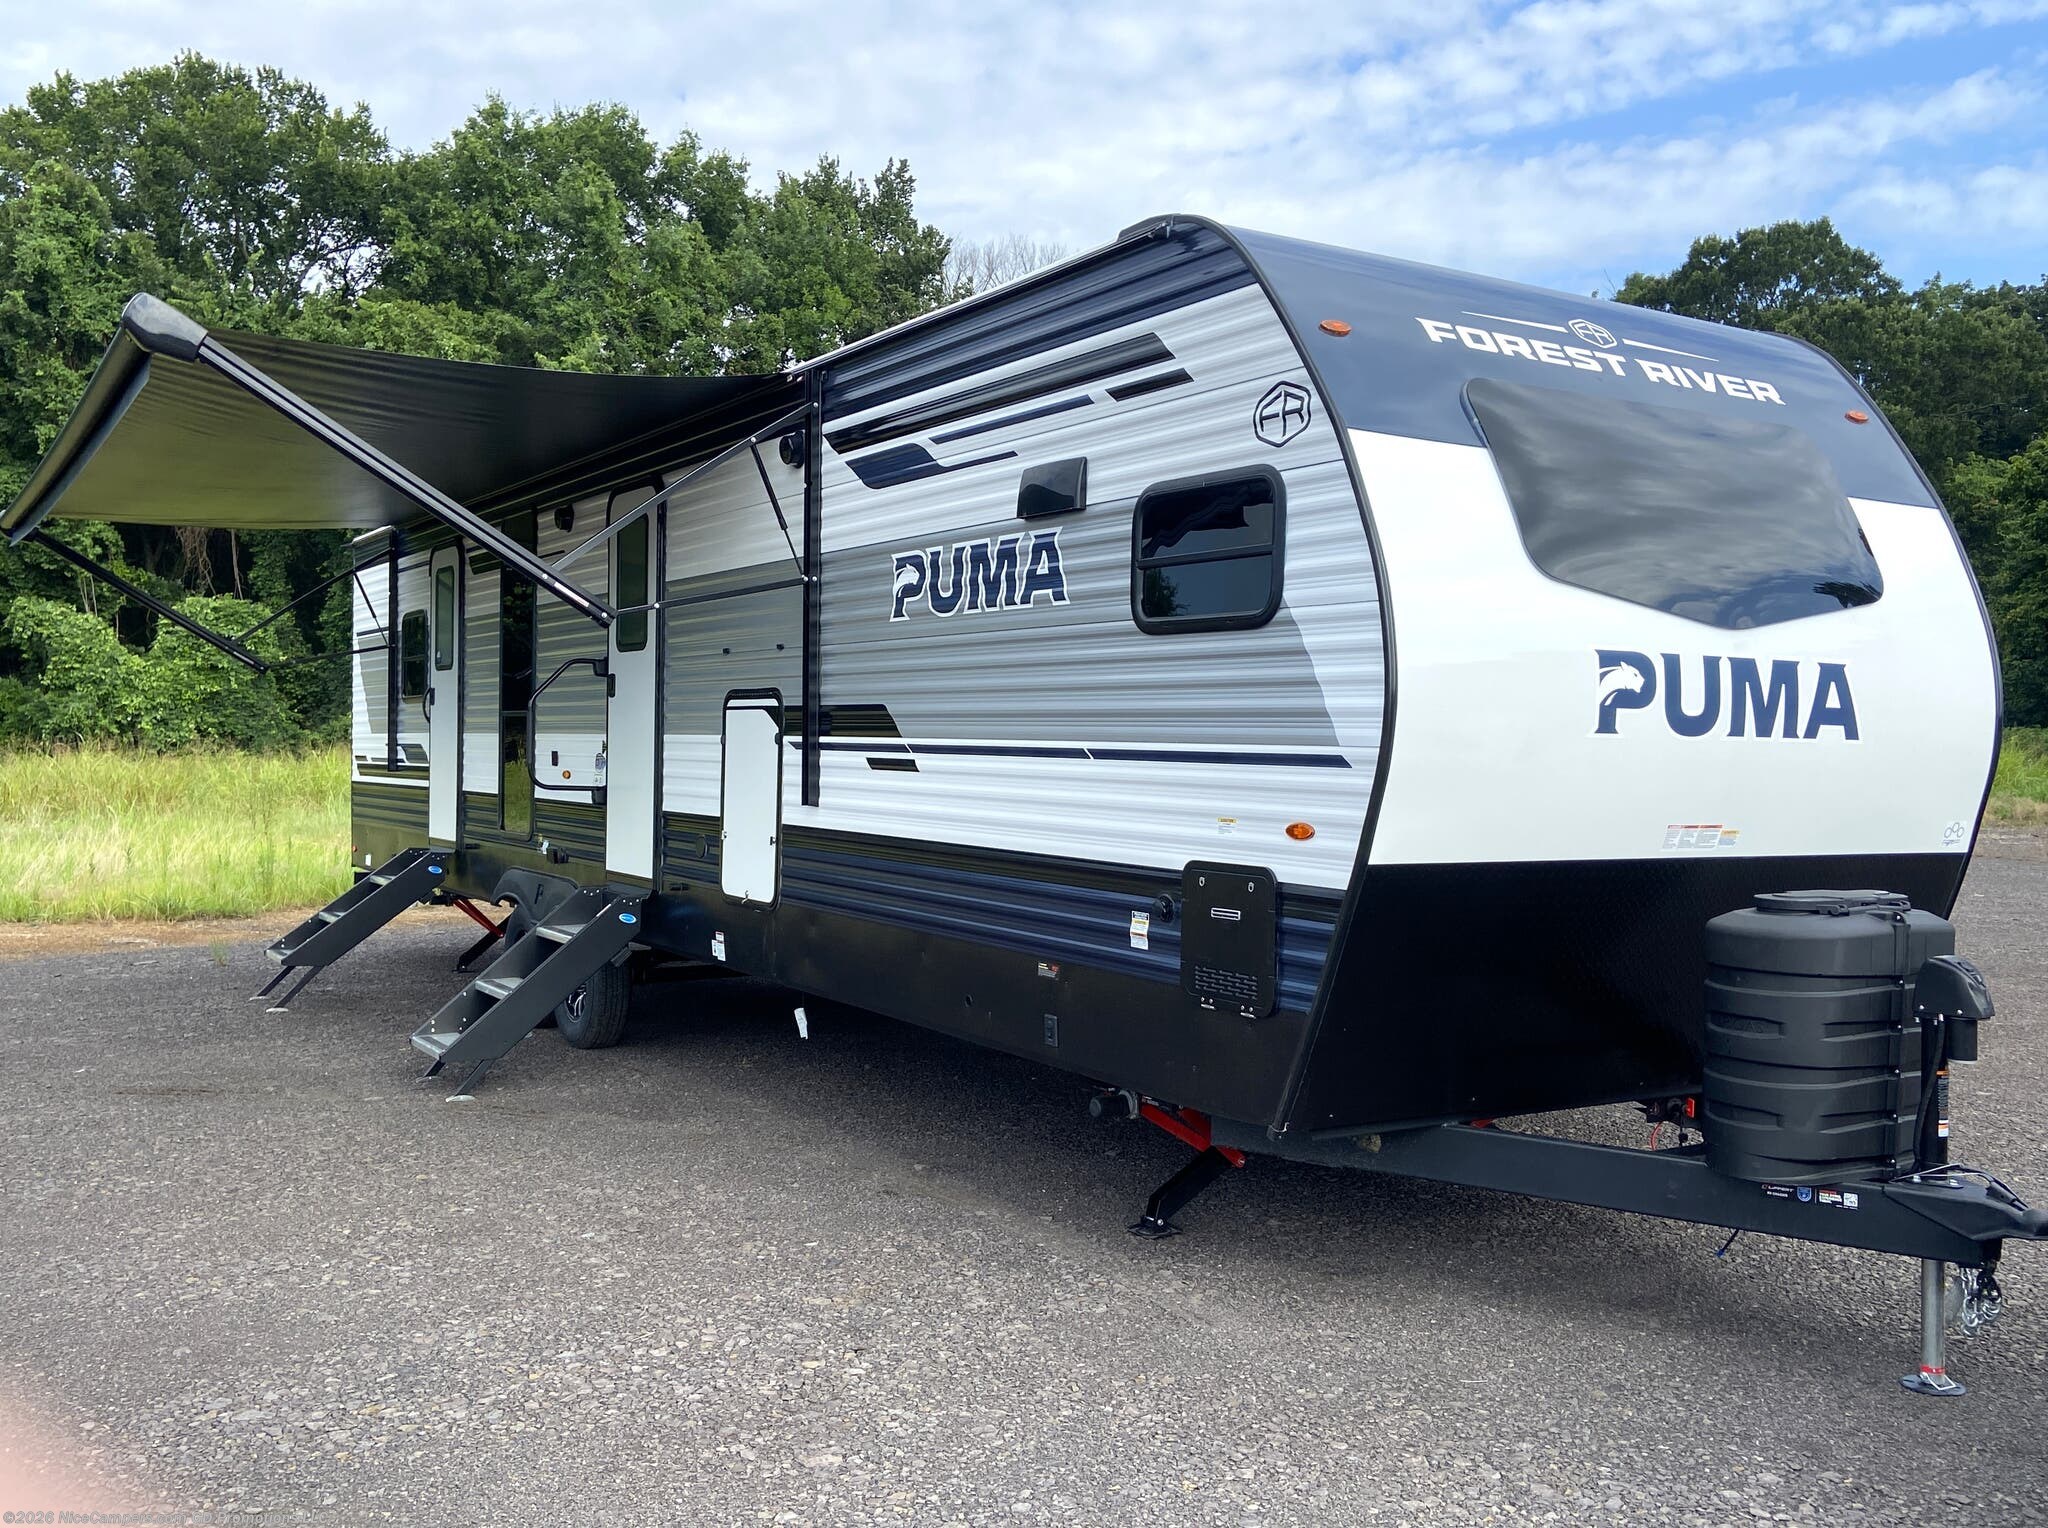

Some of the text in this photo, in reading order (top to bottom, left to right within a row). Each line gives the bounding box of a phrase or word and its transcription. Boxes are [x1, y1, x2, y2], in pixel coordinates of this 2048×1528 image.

[1415, 317, 1787, 406] FOREST RIVER
[889, 526, 1071, 622] PUMA
[1594, 648, 1860, 741] PUMA
